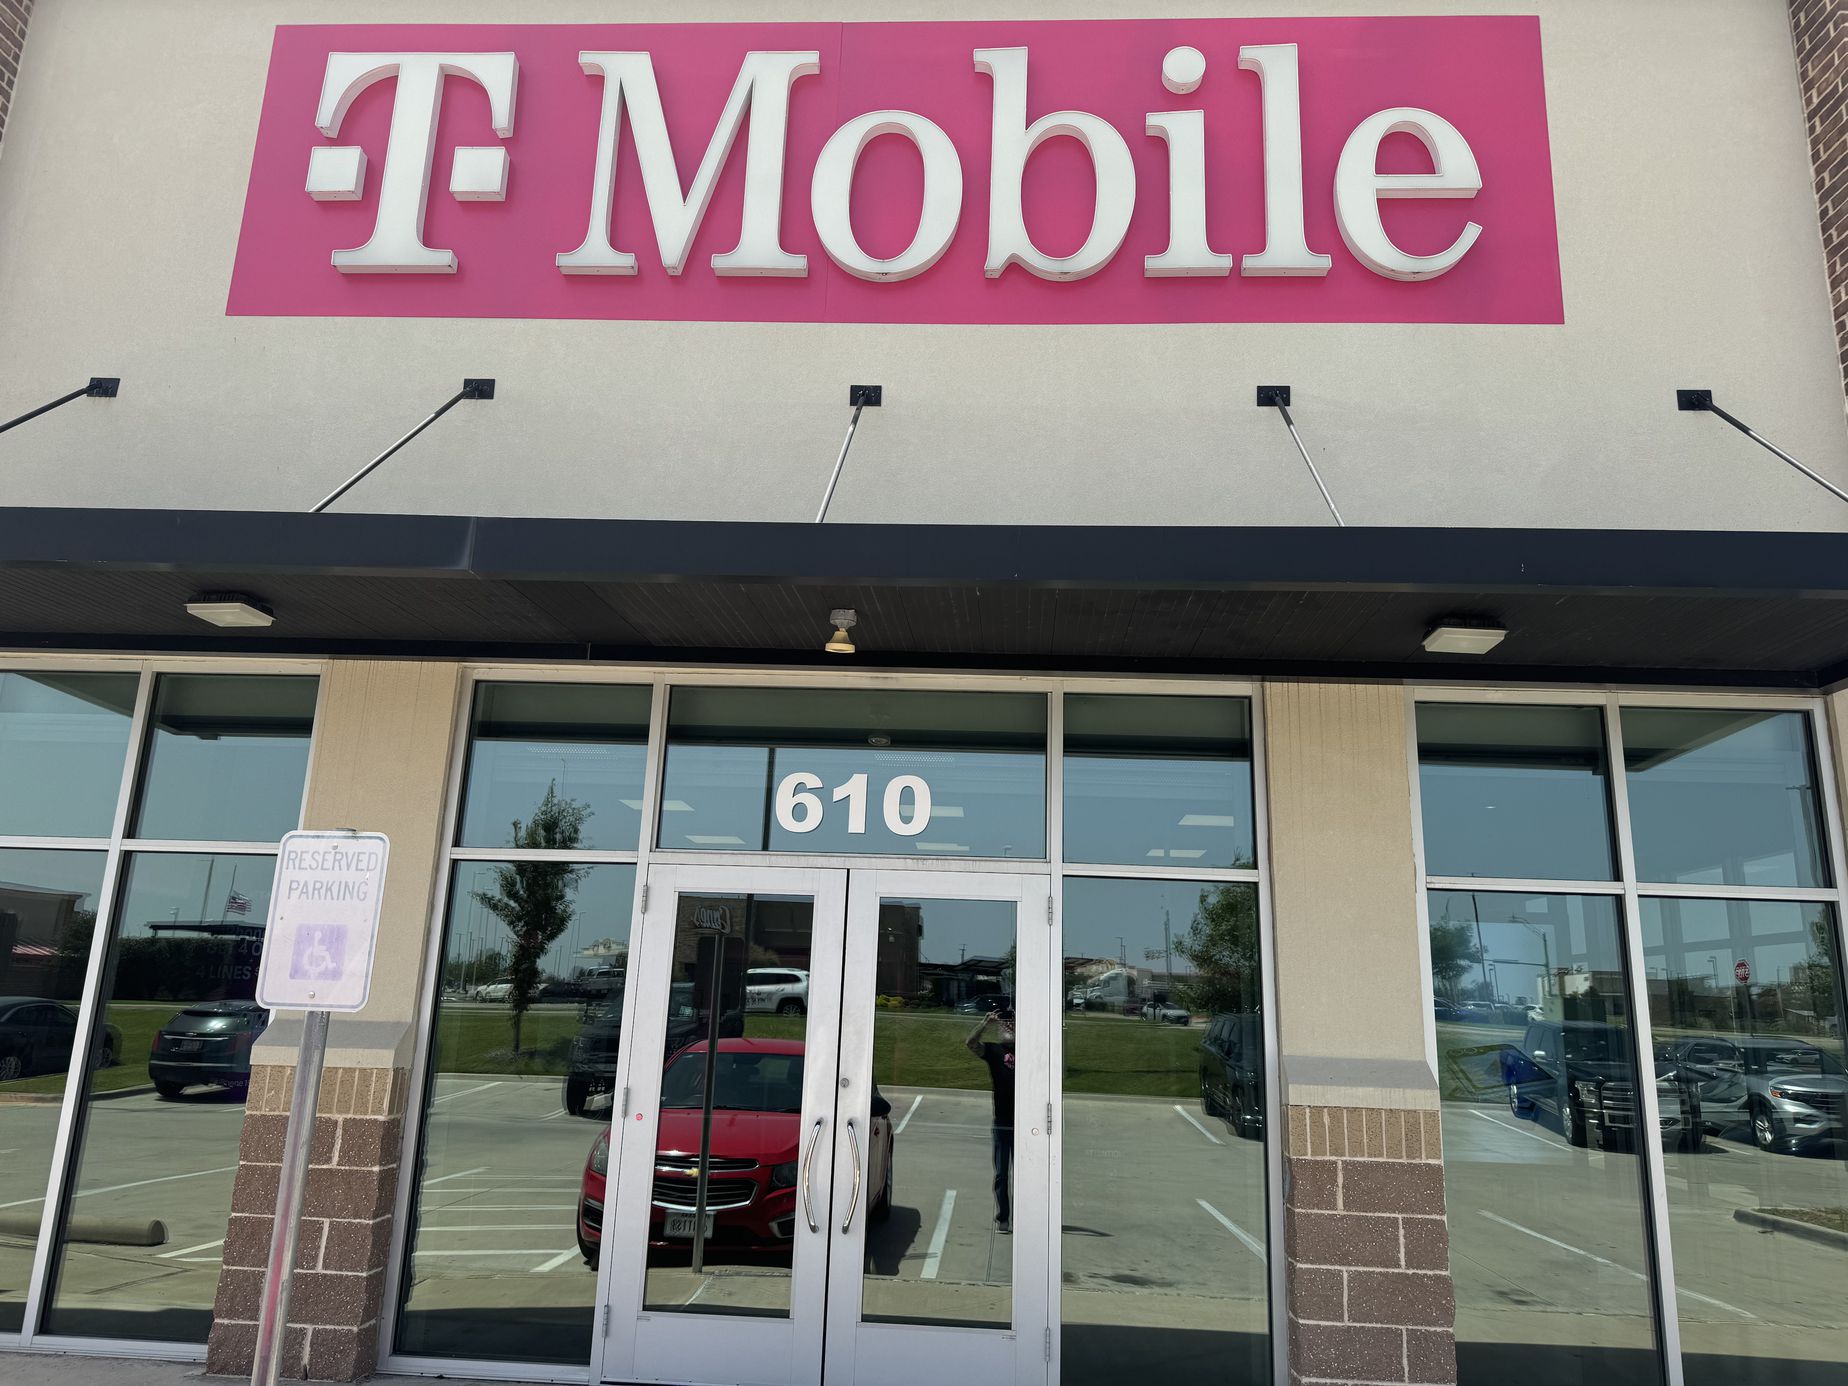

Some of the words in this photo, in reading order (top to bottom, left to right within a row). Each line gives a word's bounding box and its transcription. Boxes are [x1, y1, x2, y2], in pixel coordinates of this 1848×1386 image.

[556, 43, 1483, 284] Mobile
[775, 772, 932, 836] 610
[285, 850, 379, 872] RESERVED
[287, 879, 369, 902] PARKING
[210, 965, 253, 980] LINES
